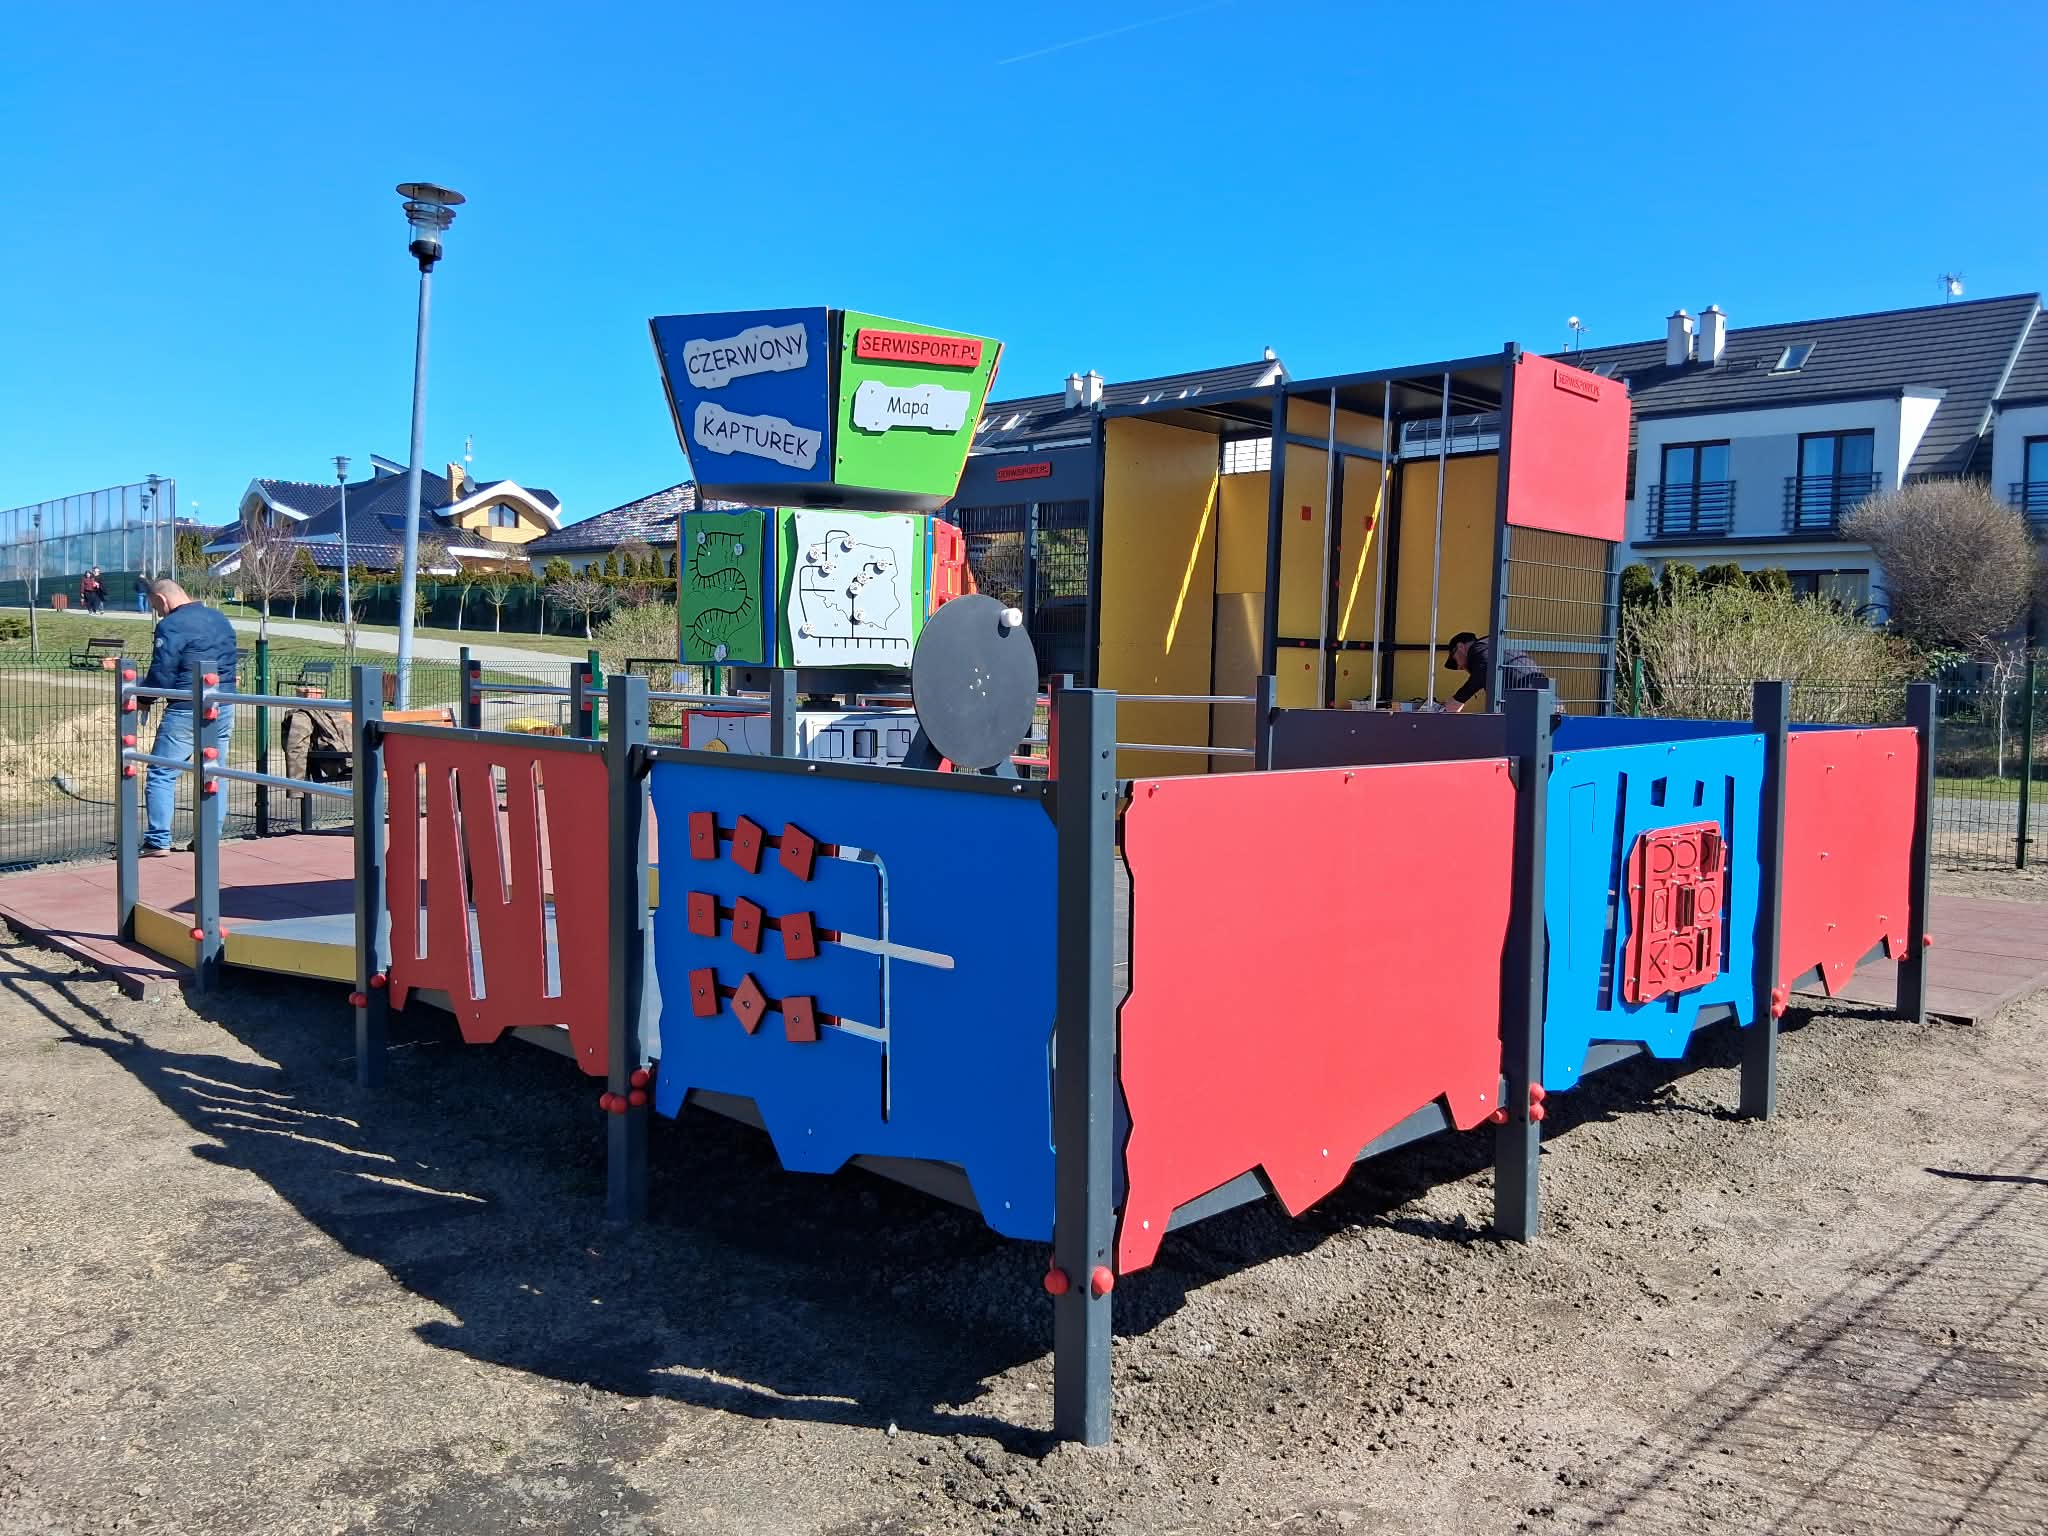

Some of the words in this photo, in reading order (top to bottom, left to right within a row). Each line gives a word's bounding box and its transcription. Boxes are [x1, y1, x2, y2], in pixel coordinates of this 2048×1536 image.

[688, 333, 803, 375] CZERWONY
[861, 335, 978, 360] SERWISPORT.PL
[886, 396, 929, 419] Mapa
[703, 416, 808, 457] KAPTUREK
